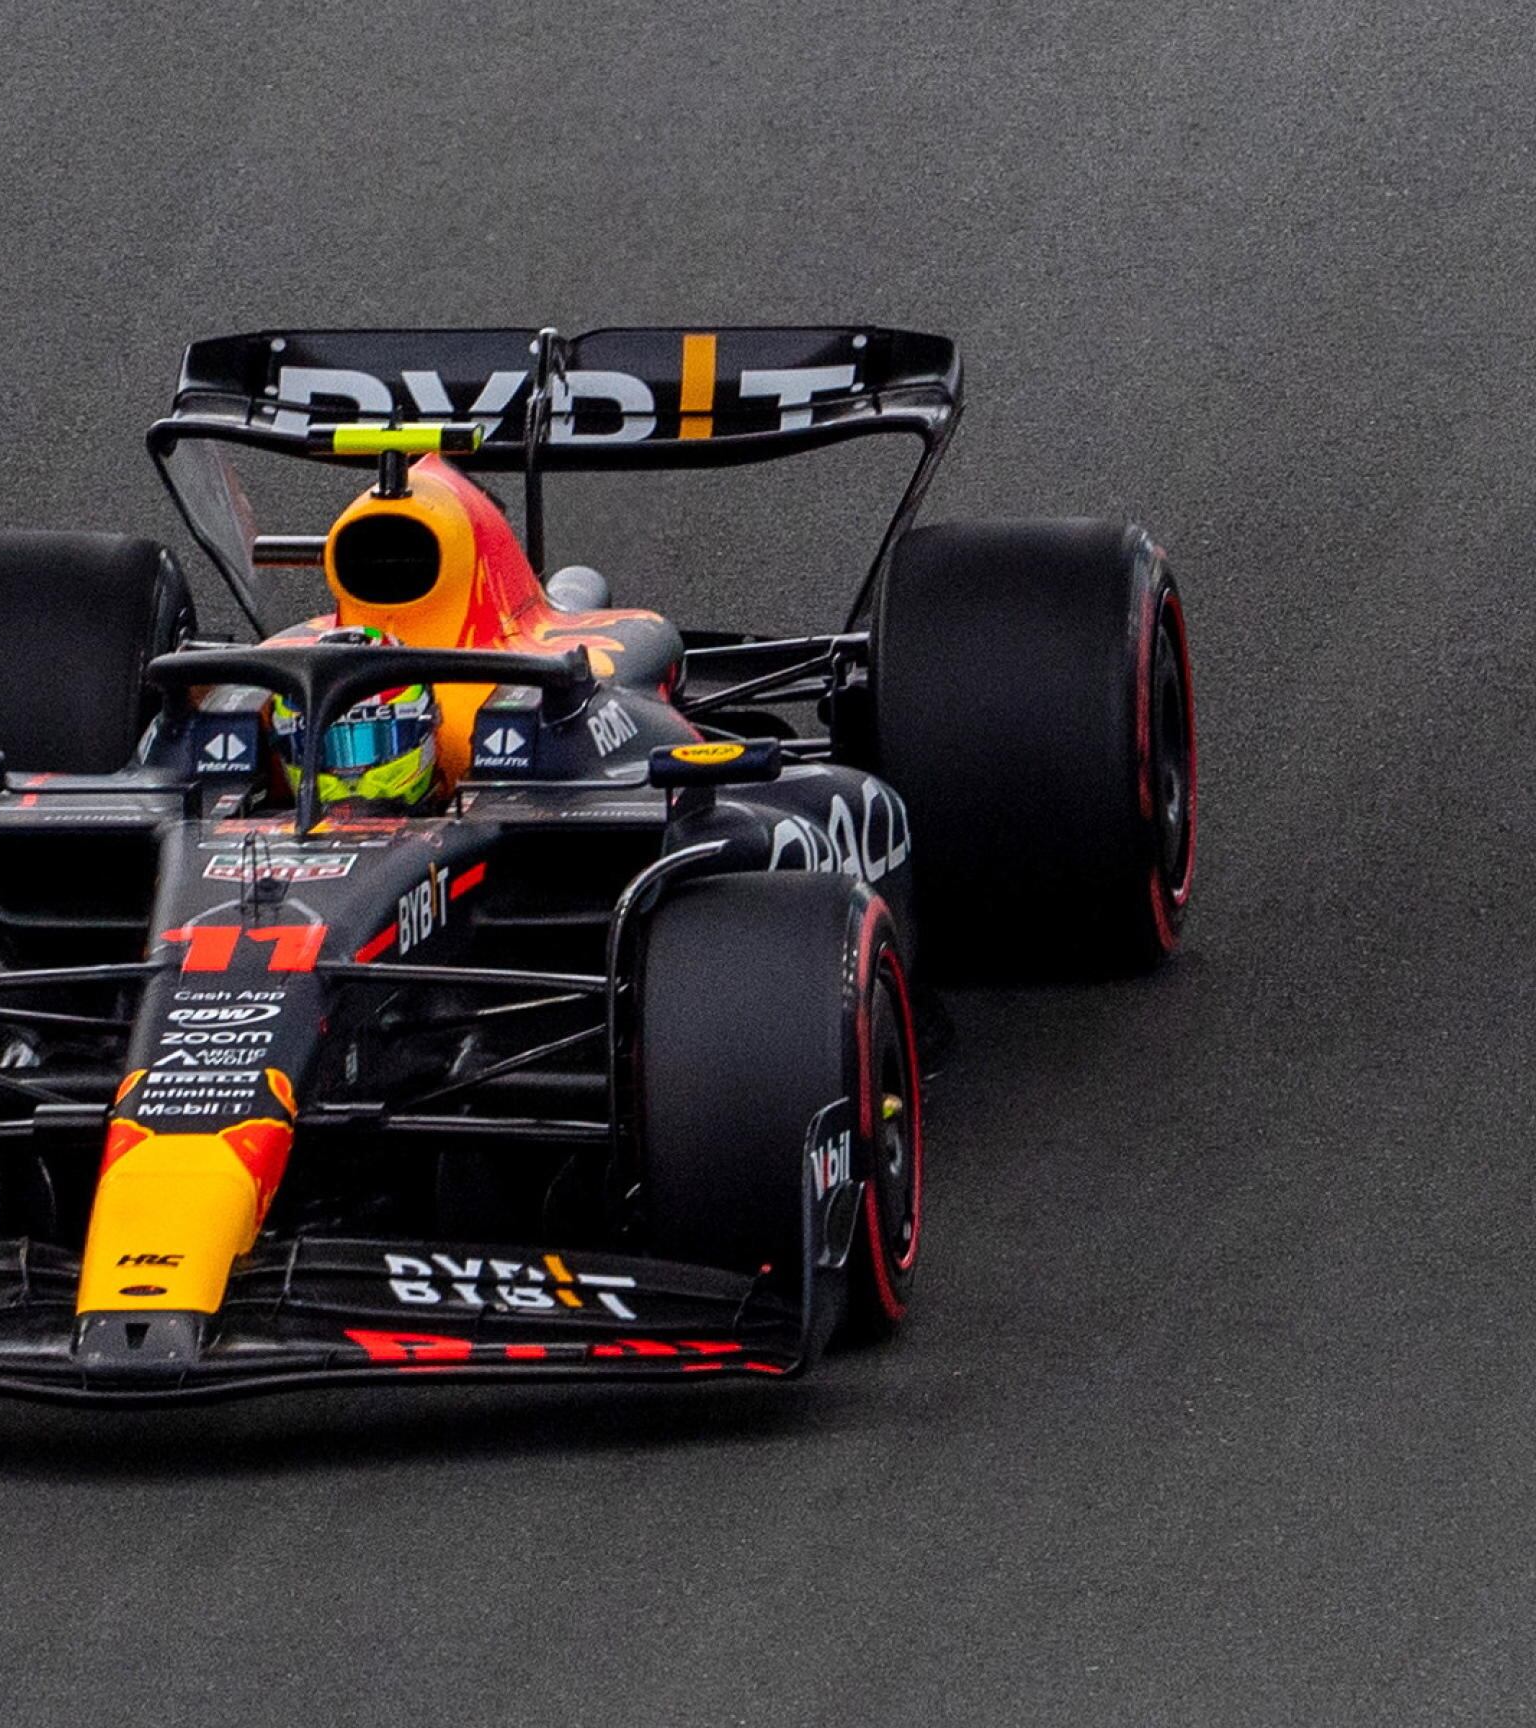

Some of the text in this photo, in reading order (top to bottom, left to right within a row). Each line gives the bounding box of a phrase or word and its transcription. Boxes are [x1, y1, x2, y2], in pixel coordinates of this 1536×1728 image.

[398, 861, 449, 956] BYBIT
[160, 925, 329, 972] 11
[174, 989, 286, 1001] Cash App
[167, 1005, 263, 1023] CDW
[160, 1031, 273, 1045] zoom
[137, 1103, 219, 1116] Mobil
[116, 1254, 184, 1268] HRC
